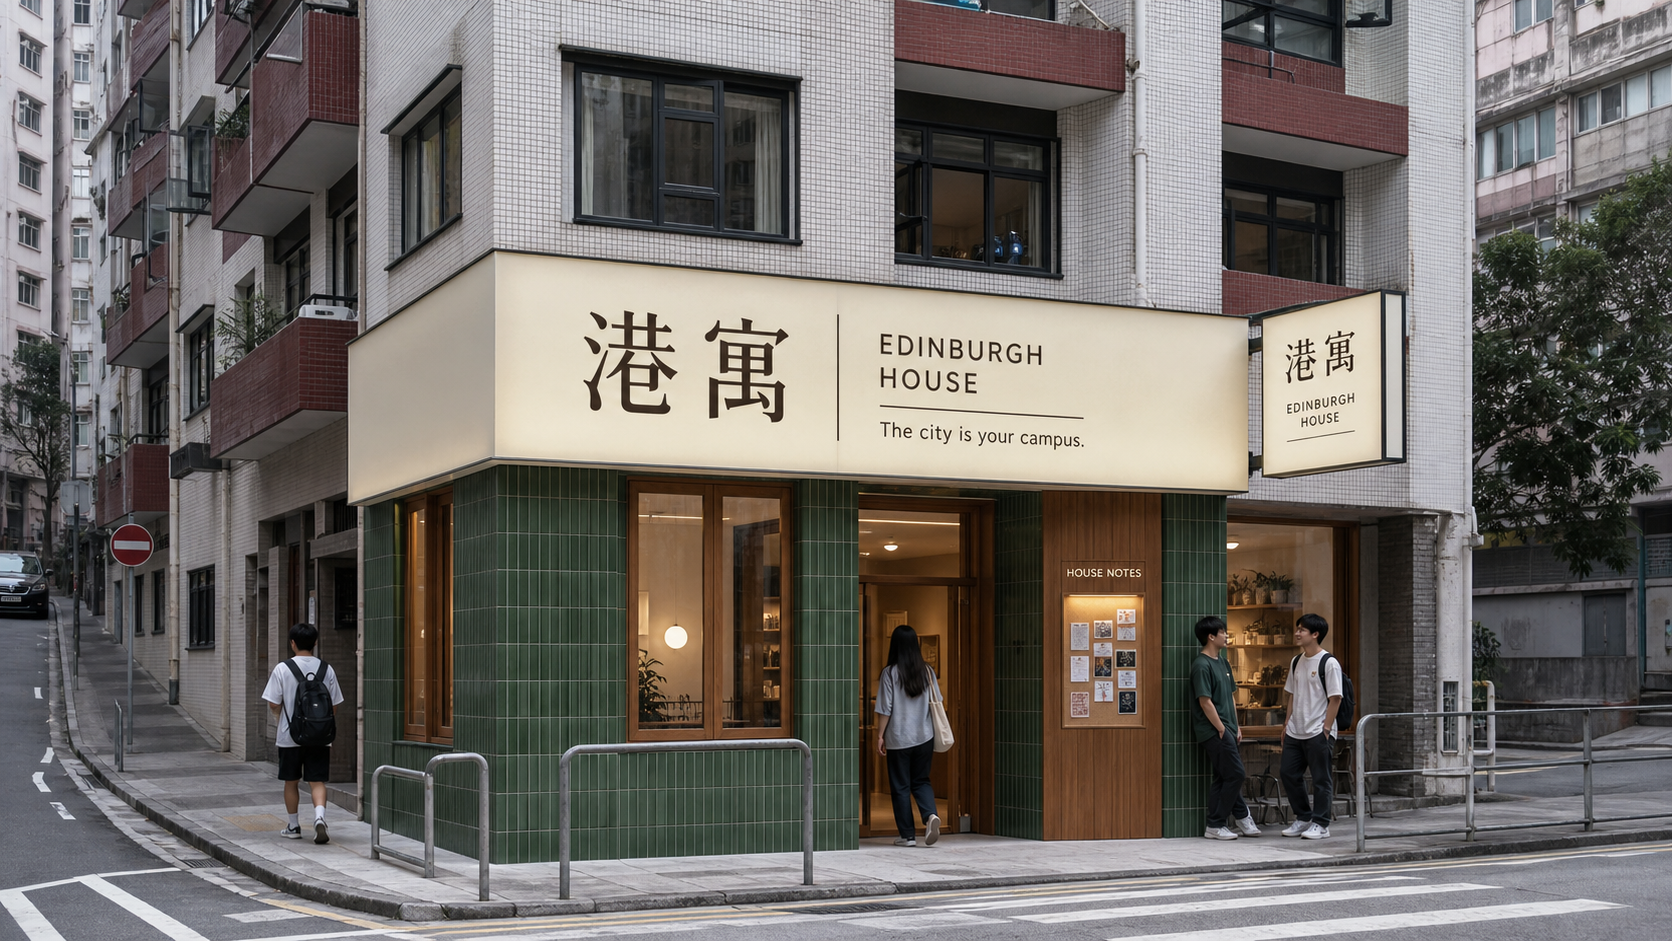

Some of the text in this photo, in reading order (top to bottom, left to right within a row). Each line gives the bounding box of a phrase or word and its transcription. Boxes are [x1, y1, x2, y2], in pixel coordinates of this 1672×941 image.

[880, 333, 1042, 366] EDINBURGH
[1285, 330, 1355, 384] 港寓
[584, 310, 789, 423] 港寓
[880, 367, 978, 395] HOUSE
[1286, 393, 1354, 414] EDINBURGH
[1301, 411, 1340, 428] HOUSE
[880, 421, 1085, 450] The city is your campus.
[1066, 568, 1142, 578] HOUSE NOTES
